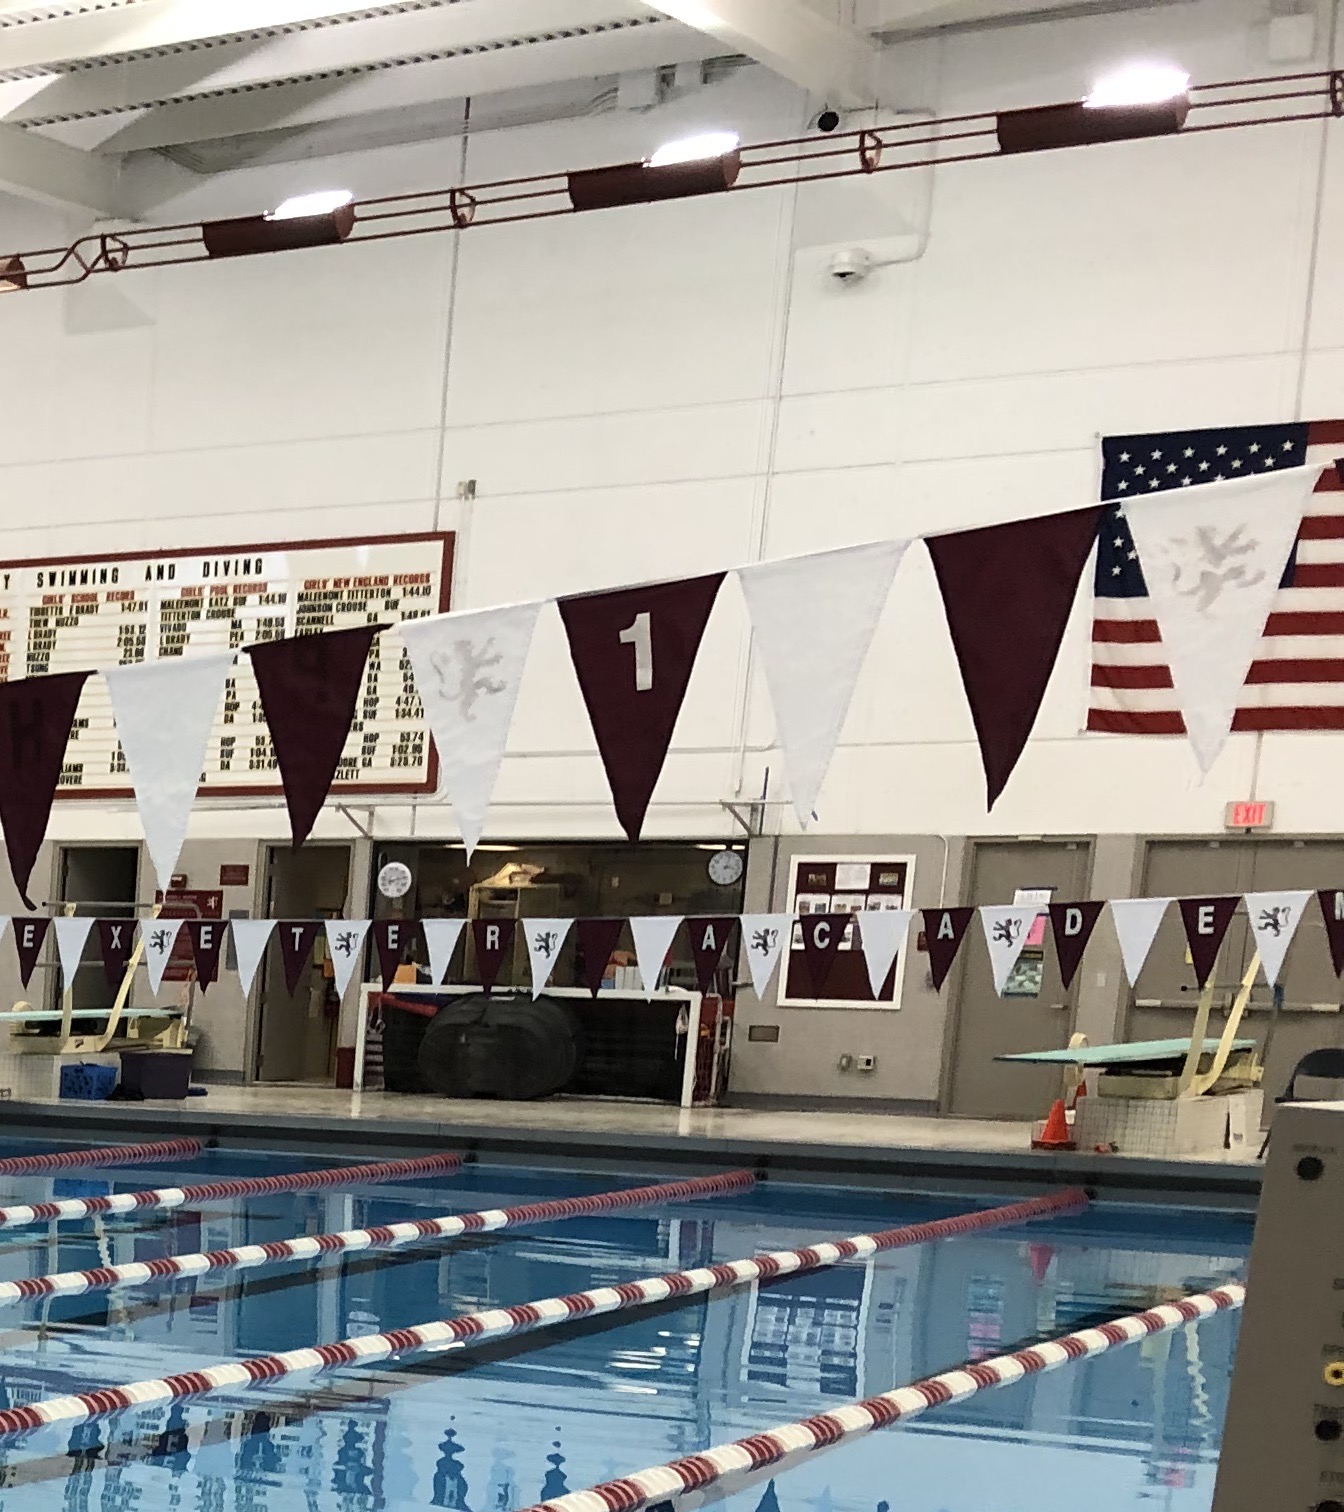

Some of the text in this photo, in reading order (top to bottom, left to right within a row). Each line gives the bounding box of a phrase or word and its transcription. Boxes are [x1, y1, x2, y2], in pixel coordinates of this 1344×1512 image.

[37, 567, 119, 588] SWIMMING
[145, 564, 176, 581] AND
[202, 558, 263, 578] DIVING
[333, 578, 349, 588] NEW
[353, 576, 389, 587] ENGLAND
[393, 573, 430, 585] RECORDS
[619, 612, 653, 691] 1
[1233, 803, 1268, 826] EXIT
[22, 925, 499, 951] E X E T E R
[701, 905, 1215, 949] A C A D E
